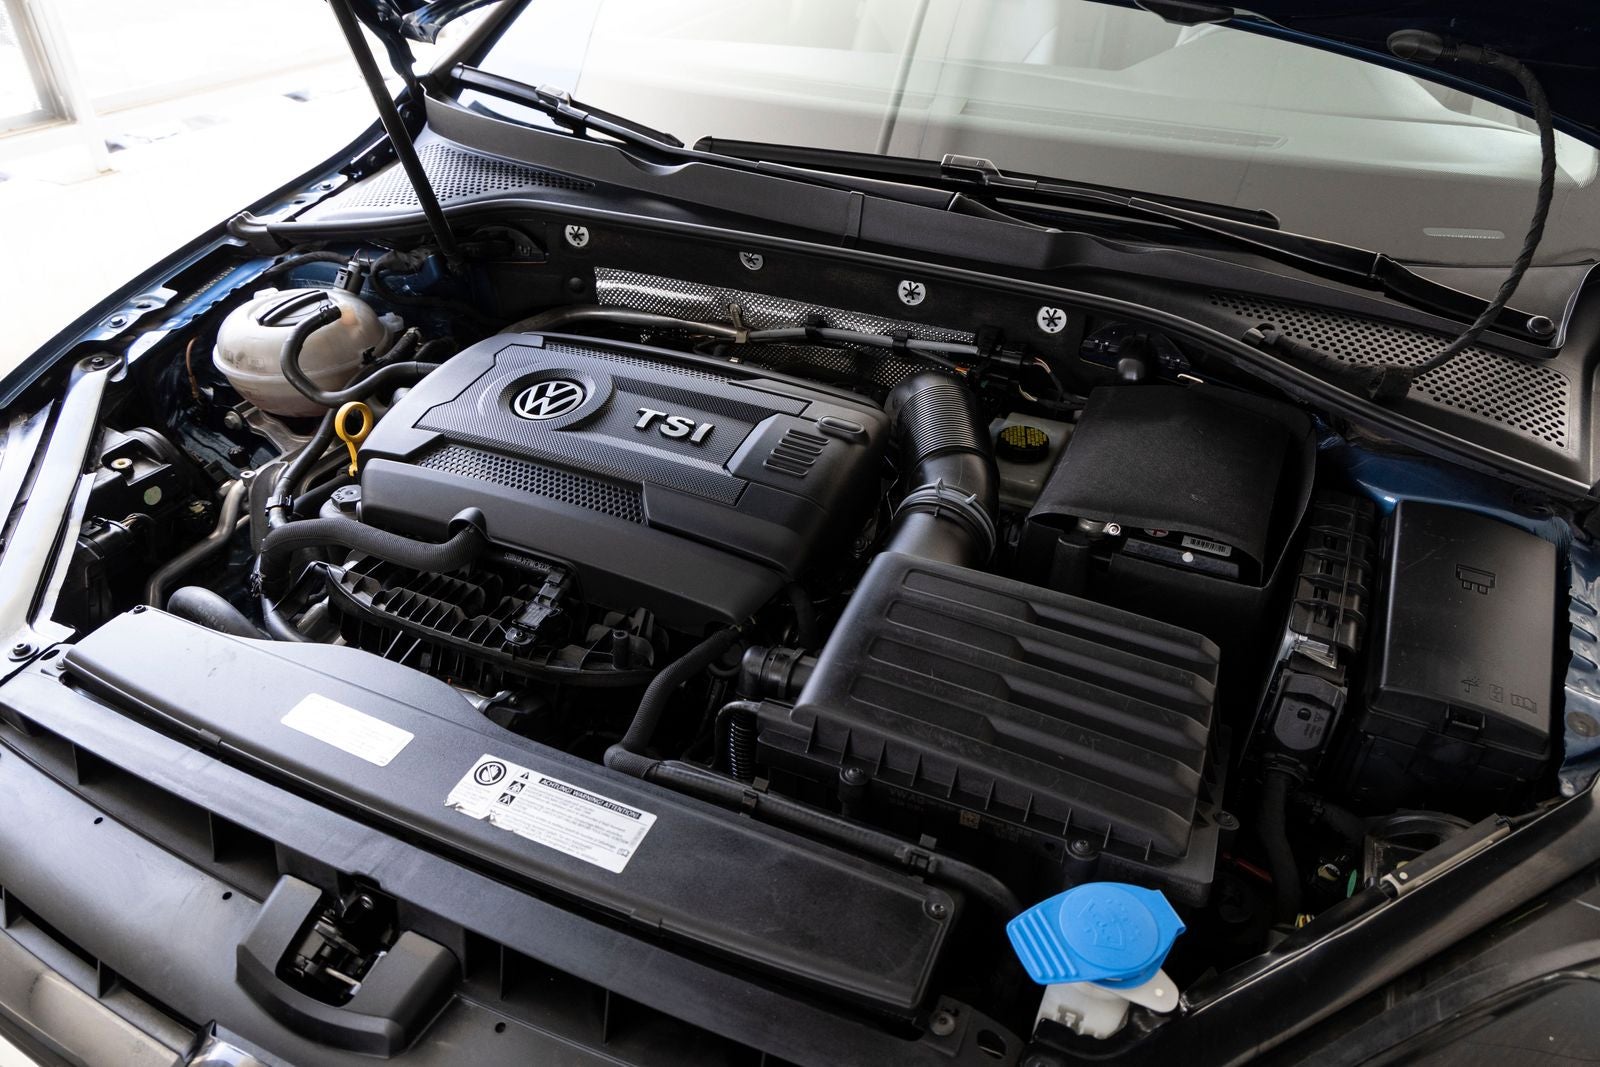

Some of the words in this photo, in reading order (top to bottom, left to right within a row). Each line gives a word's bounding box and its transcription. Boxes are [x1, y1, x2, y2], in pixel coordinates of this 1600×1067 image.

[635, 408, 714, 443] TSI
[541, 779, 573, 793] ACHTUNG!
[572, 790, 604, 805] WARNING!
[602, 802, 639, 818] ATTENTION!
